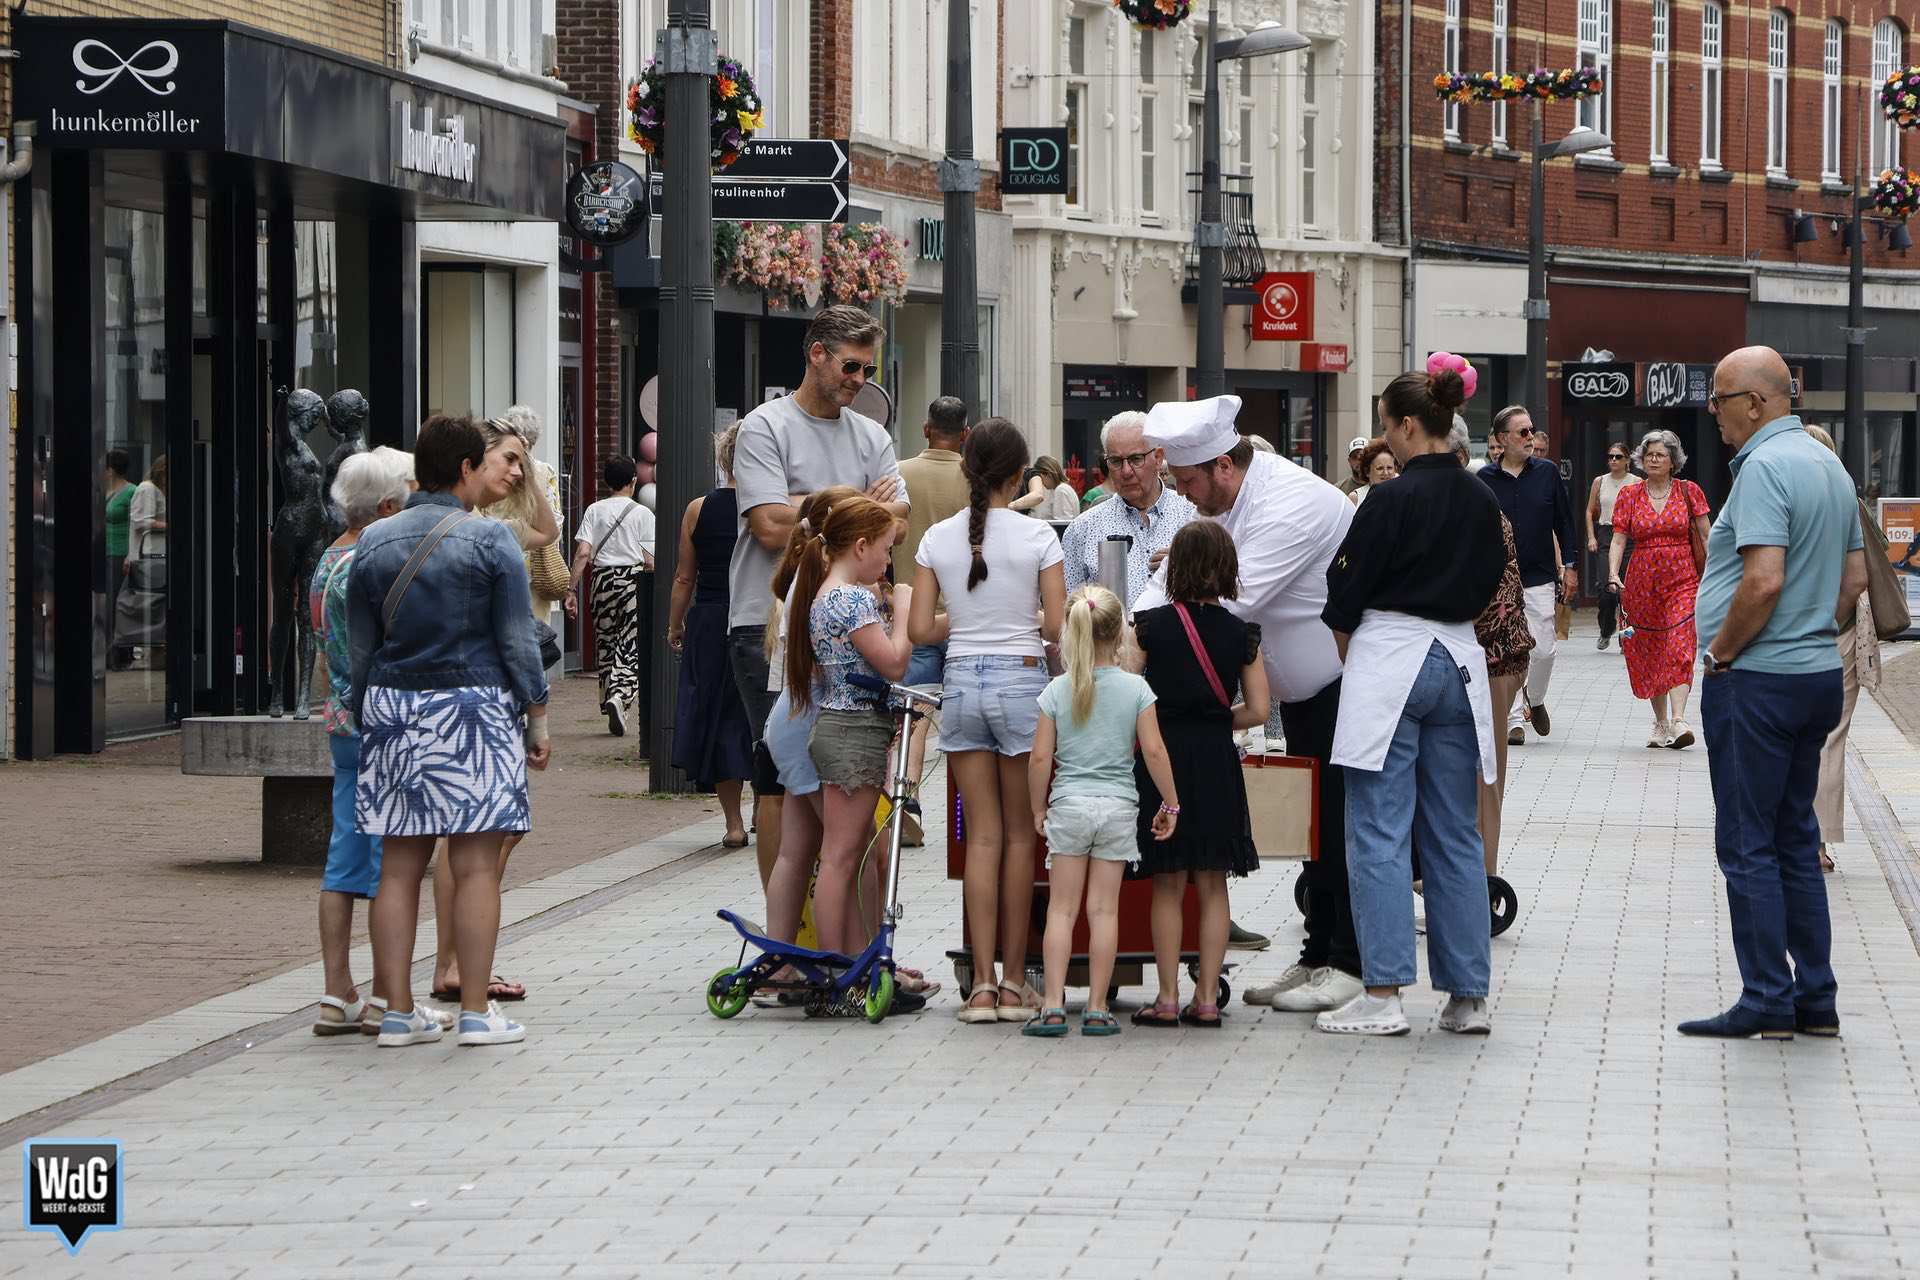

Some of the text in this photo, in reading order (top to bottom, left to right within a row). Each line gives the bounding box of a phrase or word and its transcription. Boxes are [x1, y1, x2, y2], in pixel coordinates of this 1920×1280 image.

[755, 145, 793, 155] Markt
[1009, 174, 1060, 185] DOUGLAS
[710, 187, 786, 198] rsulinenhof
[1262, 321, 1298, 331] Kruidvat
[1574, 377, 1610, 392] BAL
[1651, 368, 1675, 404] BAL
